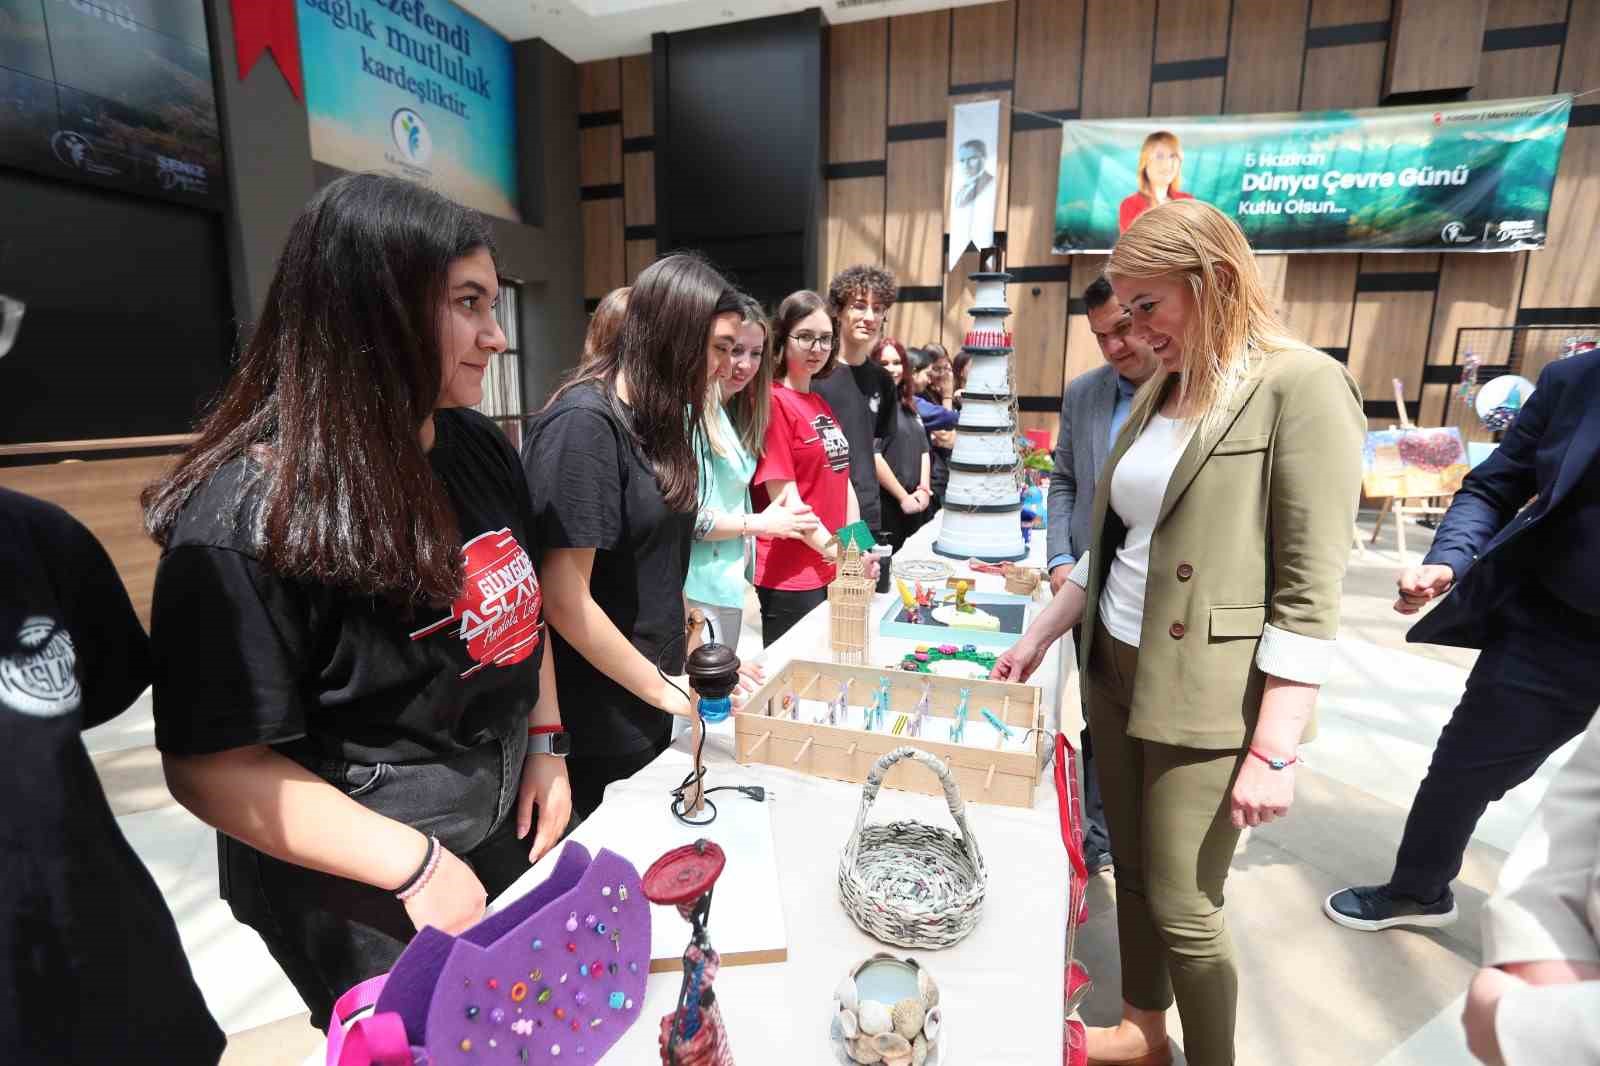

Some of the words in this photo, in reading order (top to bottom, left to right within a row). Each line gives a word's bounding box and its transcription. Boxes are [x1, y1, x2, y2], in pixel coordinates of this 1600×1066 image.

[360, 45, 471, 120] kardeşliktir.
[386, 25, 491, 99] mutluluk
[1241, 172, 1319, 195] Dünya
[1322, 170, 1394, 195] Çevre
[1398, 164, 1470, 188] Günü
[1259, 151, 1325, 167] Haziran
[1238, 200, 1281, 216] Kutlu
[1285, 199, 1347, 214] Olsun...
[460, 572, 539, 640] ASLAN
